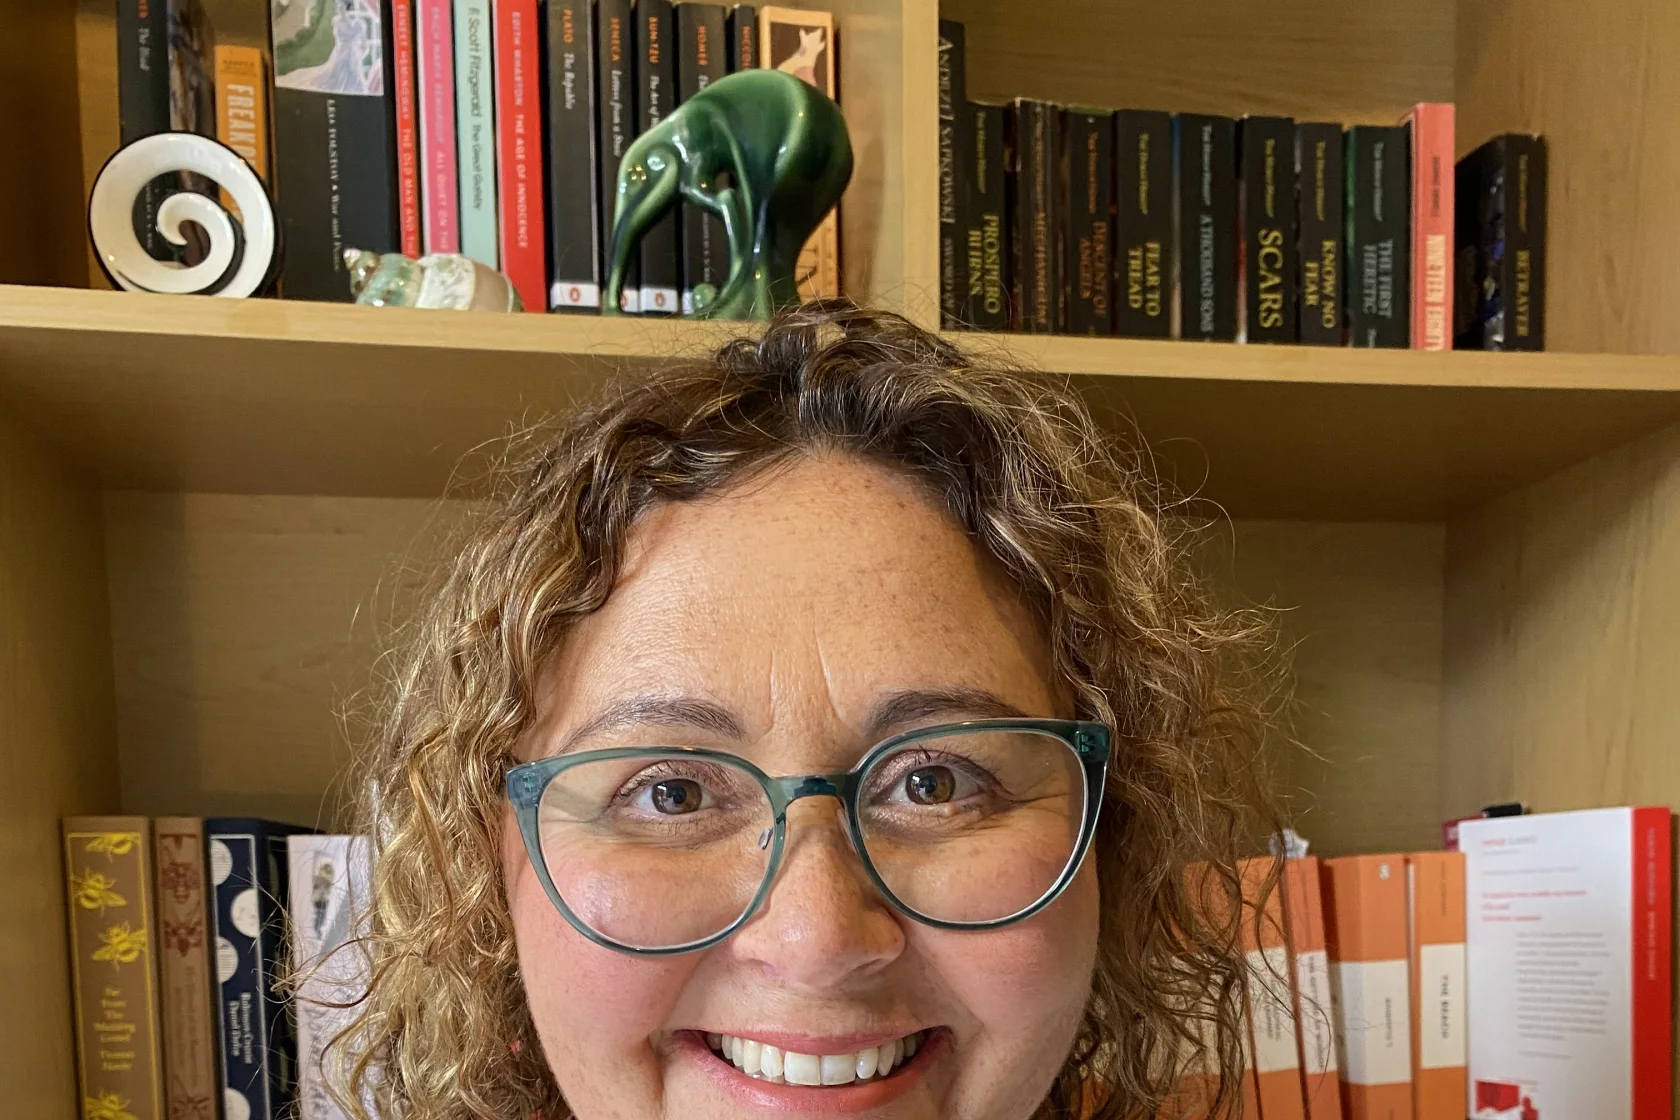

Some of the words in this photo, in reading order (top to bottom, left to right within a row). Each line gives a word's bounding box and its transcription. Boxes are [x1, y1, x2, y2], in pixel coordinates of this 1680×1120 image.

[467, 17, 481, 53] Scott
[511, 11, 523, 46] EDITH
[563, 9, 574, 44] PLATO
[610, 17, 621, 62] SENECA
[563, 53, 576, 70] The
[697, 25, 708, 66] HOMER
[467, 55, 483, 117] Fitzgerald
[513, 49, 524, 106] WHARTON
[562, 71, 576, 110] Republic
[649, 75, 660, 90] The
[609, 101, 622, 125] from
[648, 106, 660, 116] of
[649, 91, 660, 105] Art
[226, 84, 257, 168] FREAKO
[401, 128, 412, 149] THE
[471, 124, 483, 142] The
[514, 113, 525, 133] THE
[402, 152, 413, 174] OLD
[435, 151, 447, 170] ALL
[472, 143, 483, 172] Great
[515, 137, 526, 160] AGE
[516, 164, 527, 179] OF
[403, 177, 414, 204] MAN
[436, 174, 448, 207] QUIET
[470, 173, 483, 211] Gatsby
[405, 207, 415, 231] AND
[438, 210, 449, 227] ON
[517, 183, 529, 249] INNOCENCE
[439, 230, 450, 250] THE
[1377, 239, 1393, 274] THE
[983, 214, 1001, 314] PROSPERO
[1127, 248, 1143, 308] TREAD
[1145, 242, 1161, 288] FEAR
[1257, 229, 1284, 328] SCARS
[1321, 240, 1337, 297] KNOW
[1362, 244, 1378, 315] HERETIC
[1426, 234, 1446, 303] NINETEEN
[1304, 261, 1319, 307] FEAR
[1378, 276, 1393, 319] FIRST
[1145, 291, 1161, 316] TO
[1321, 301, 1337, 328] NO
